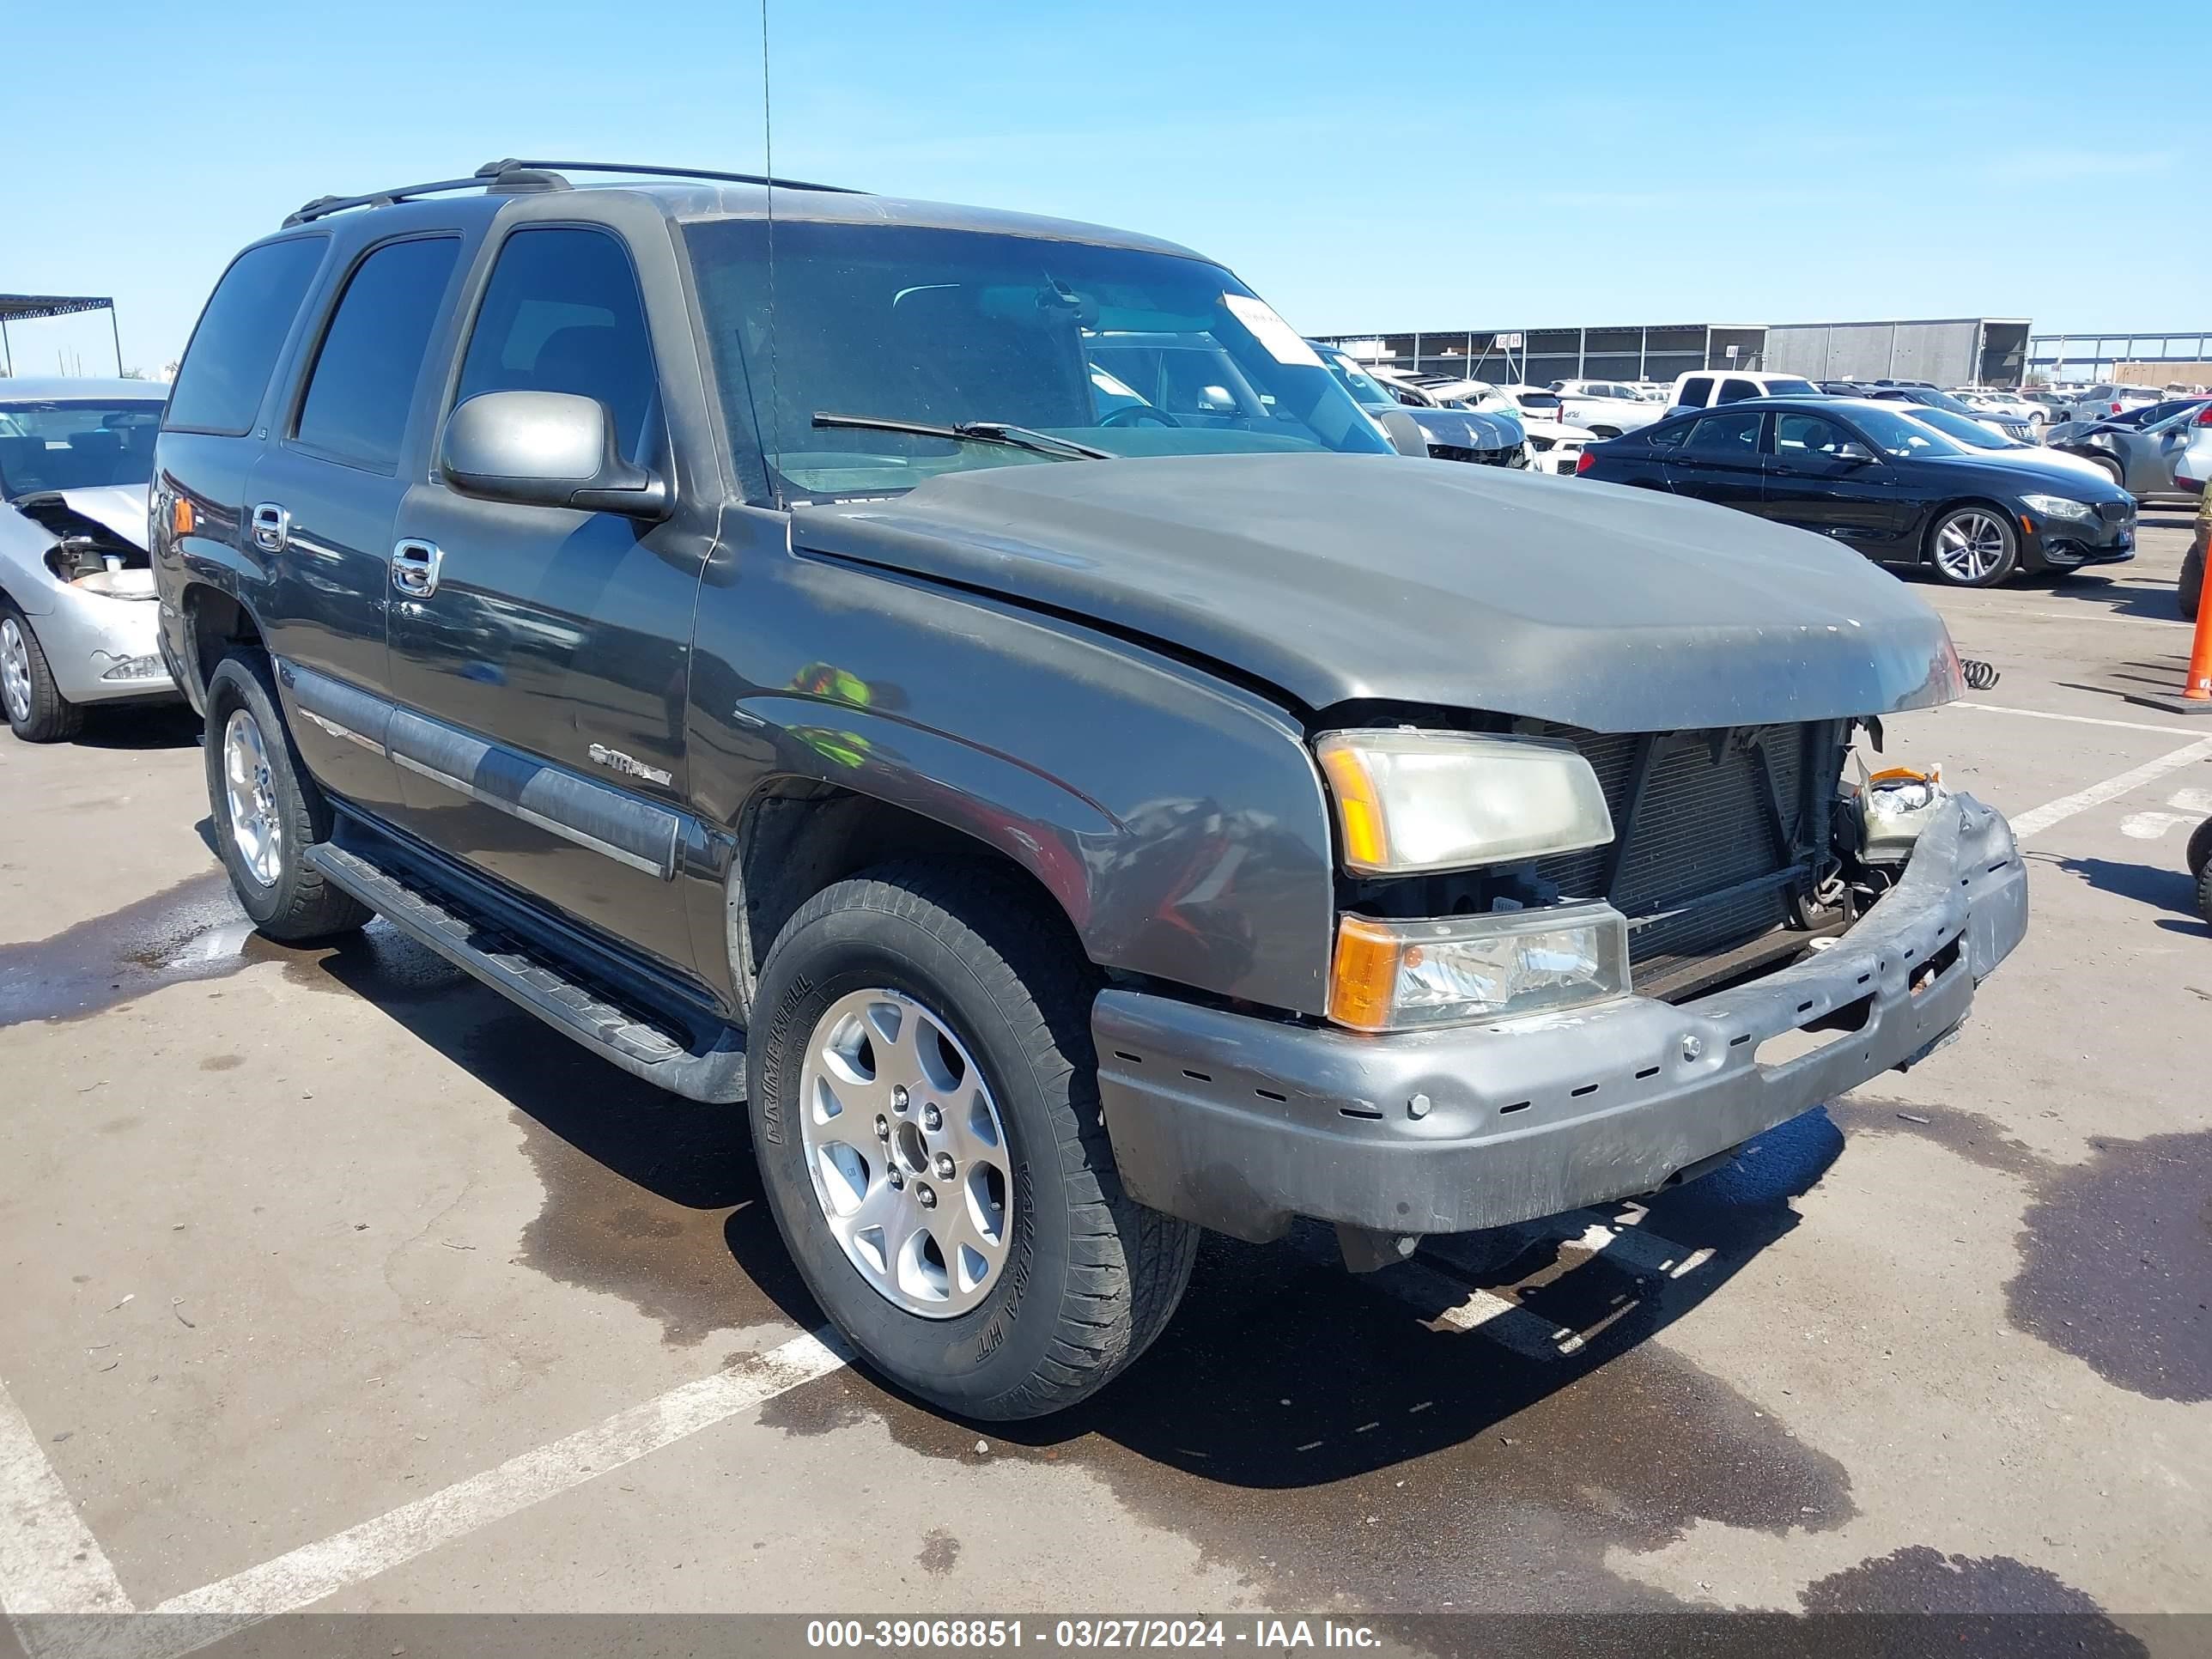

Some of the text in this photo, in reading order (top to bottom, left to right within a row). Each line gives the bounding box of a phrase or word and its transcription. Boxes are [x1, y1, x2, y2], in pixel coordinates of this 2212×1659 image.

[1511, 335, 1520, 345] H
[761, 972, 815, 1146] PRIMEWELL
[1006, 1160, 1035, 1320] VALERA
